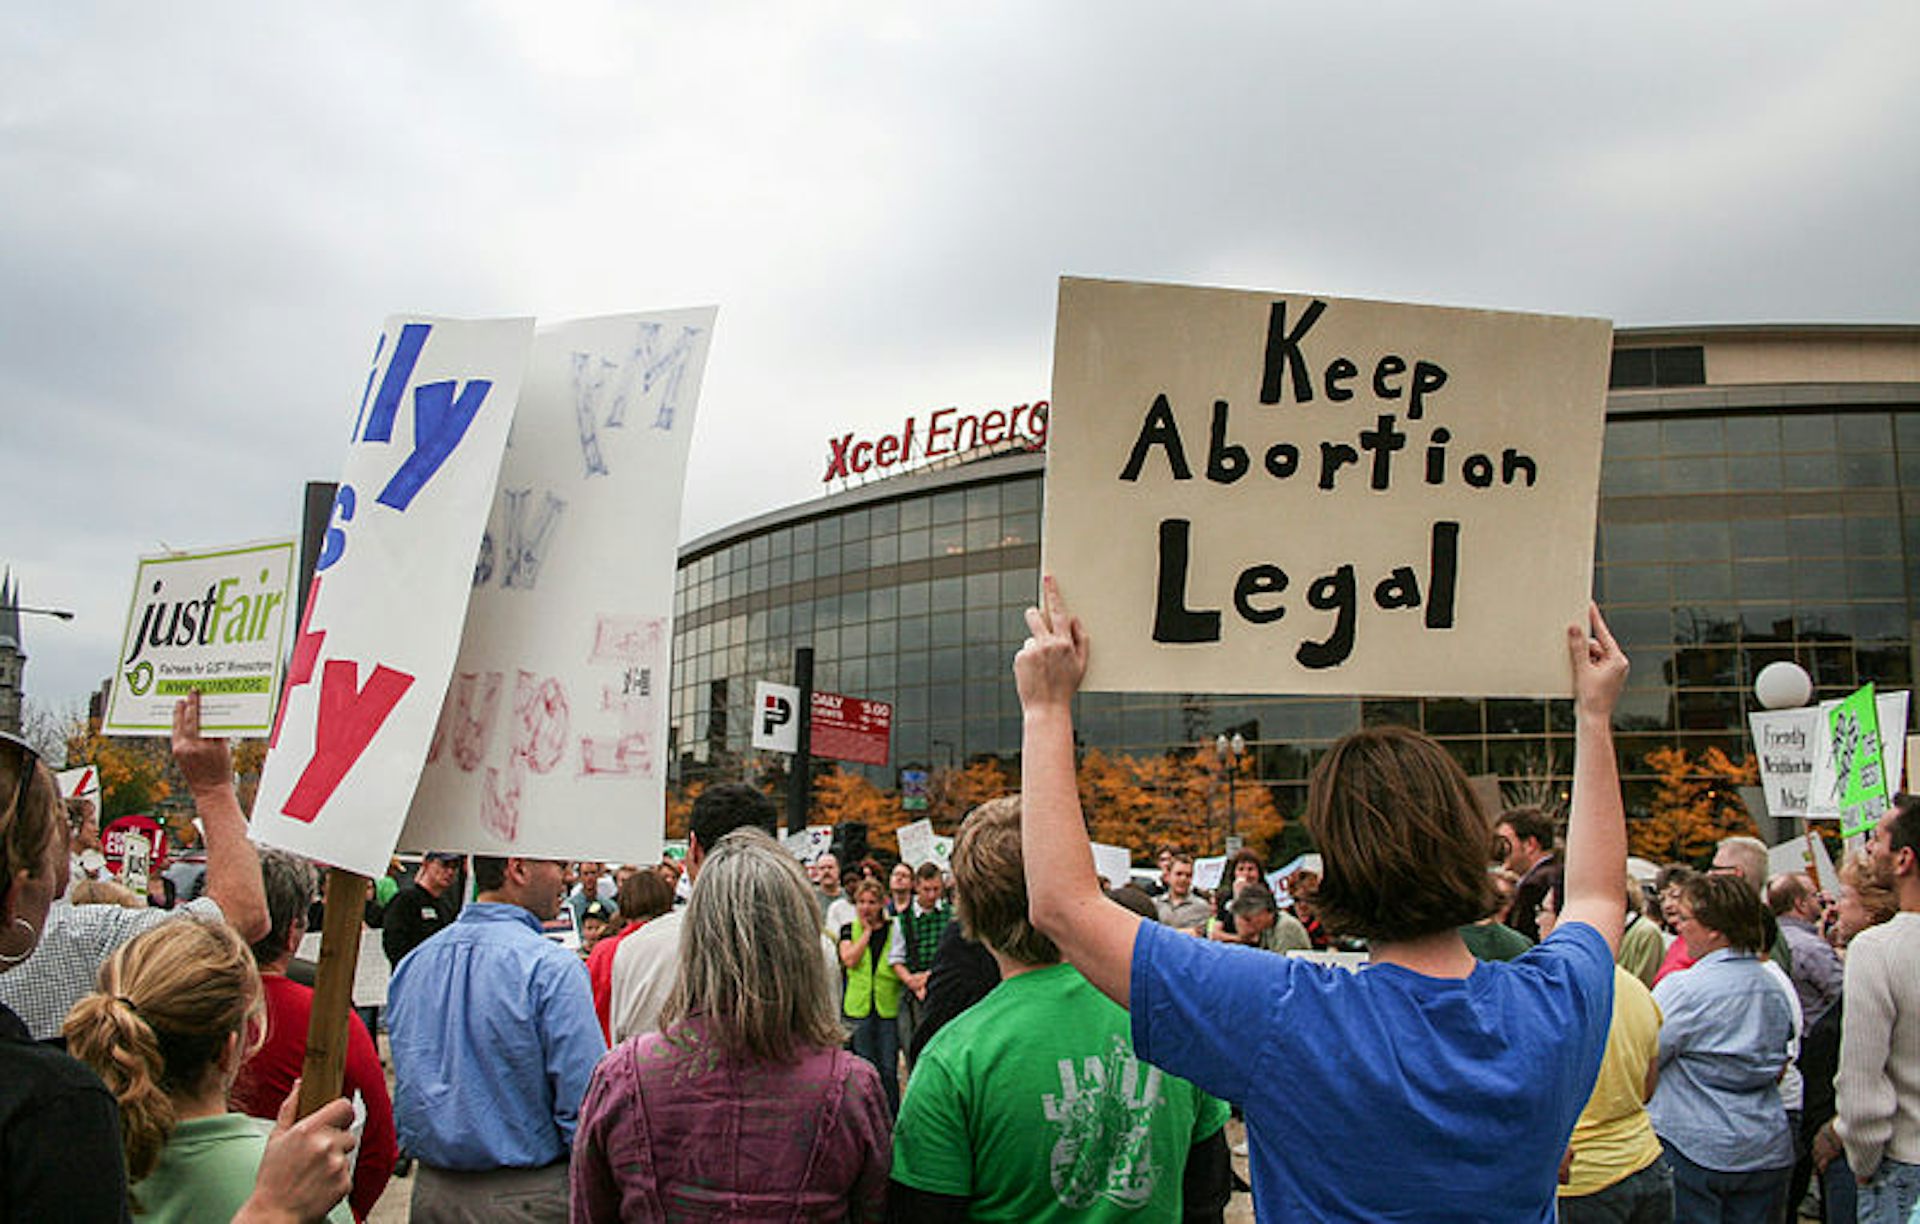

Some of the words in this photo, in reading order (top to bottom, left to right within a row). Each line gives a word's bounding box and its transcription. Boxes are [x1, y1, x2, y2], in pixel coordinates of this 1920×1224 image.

[1260, 299, 1447, 419] Keep
[823, 417, 915, 483] Xcel
[1119, 393, 1537, 490] Abortion
[1152, 518, 1459, 669] Legal
